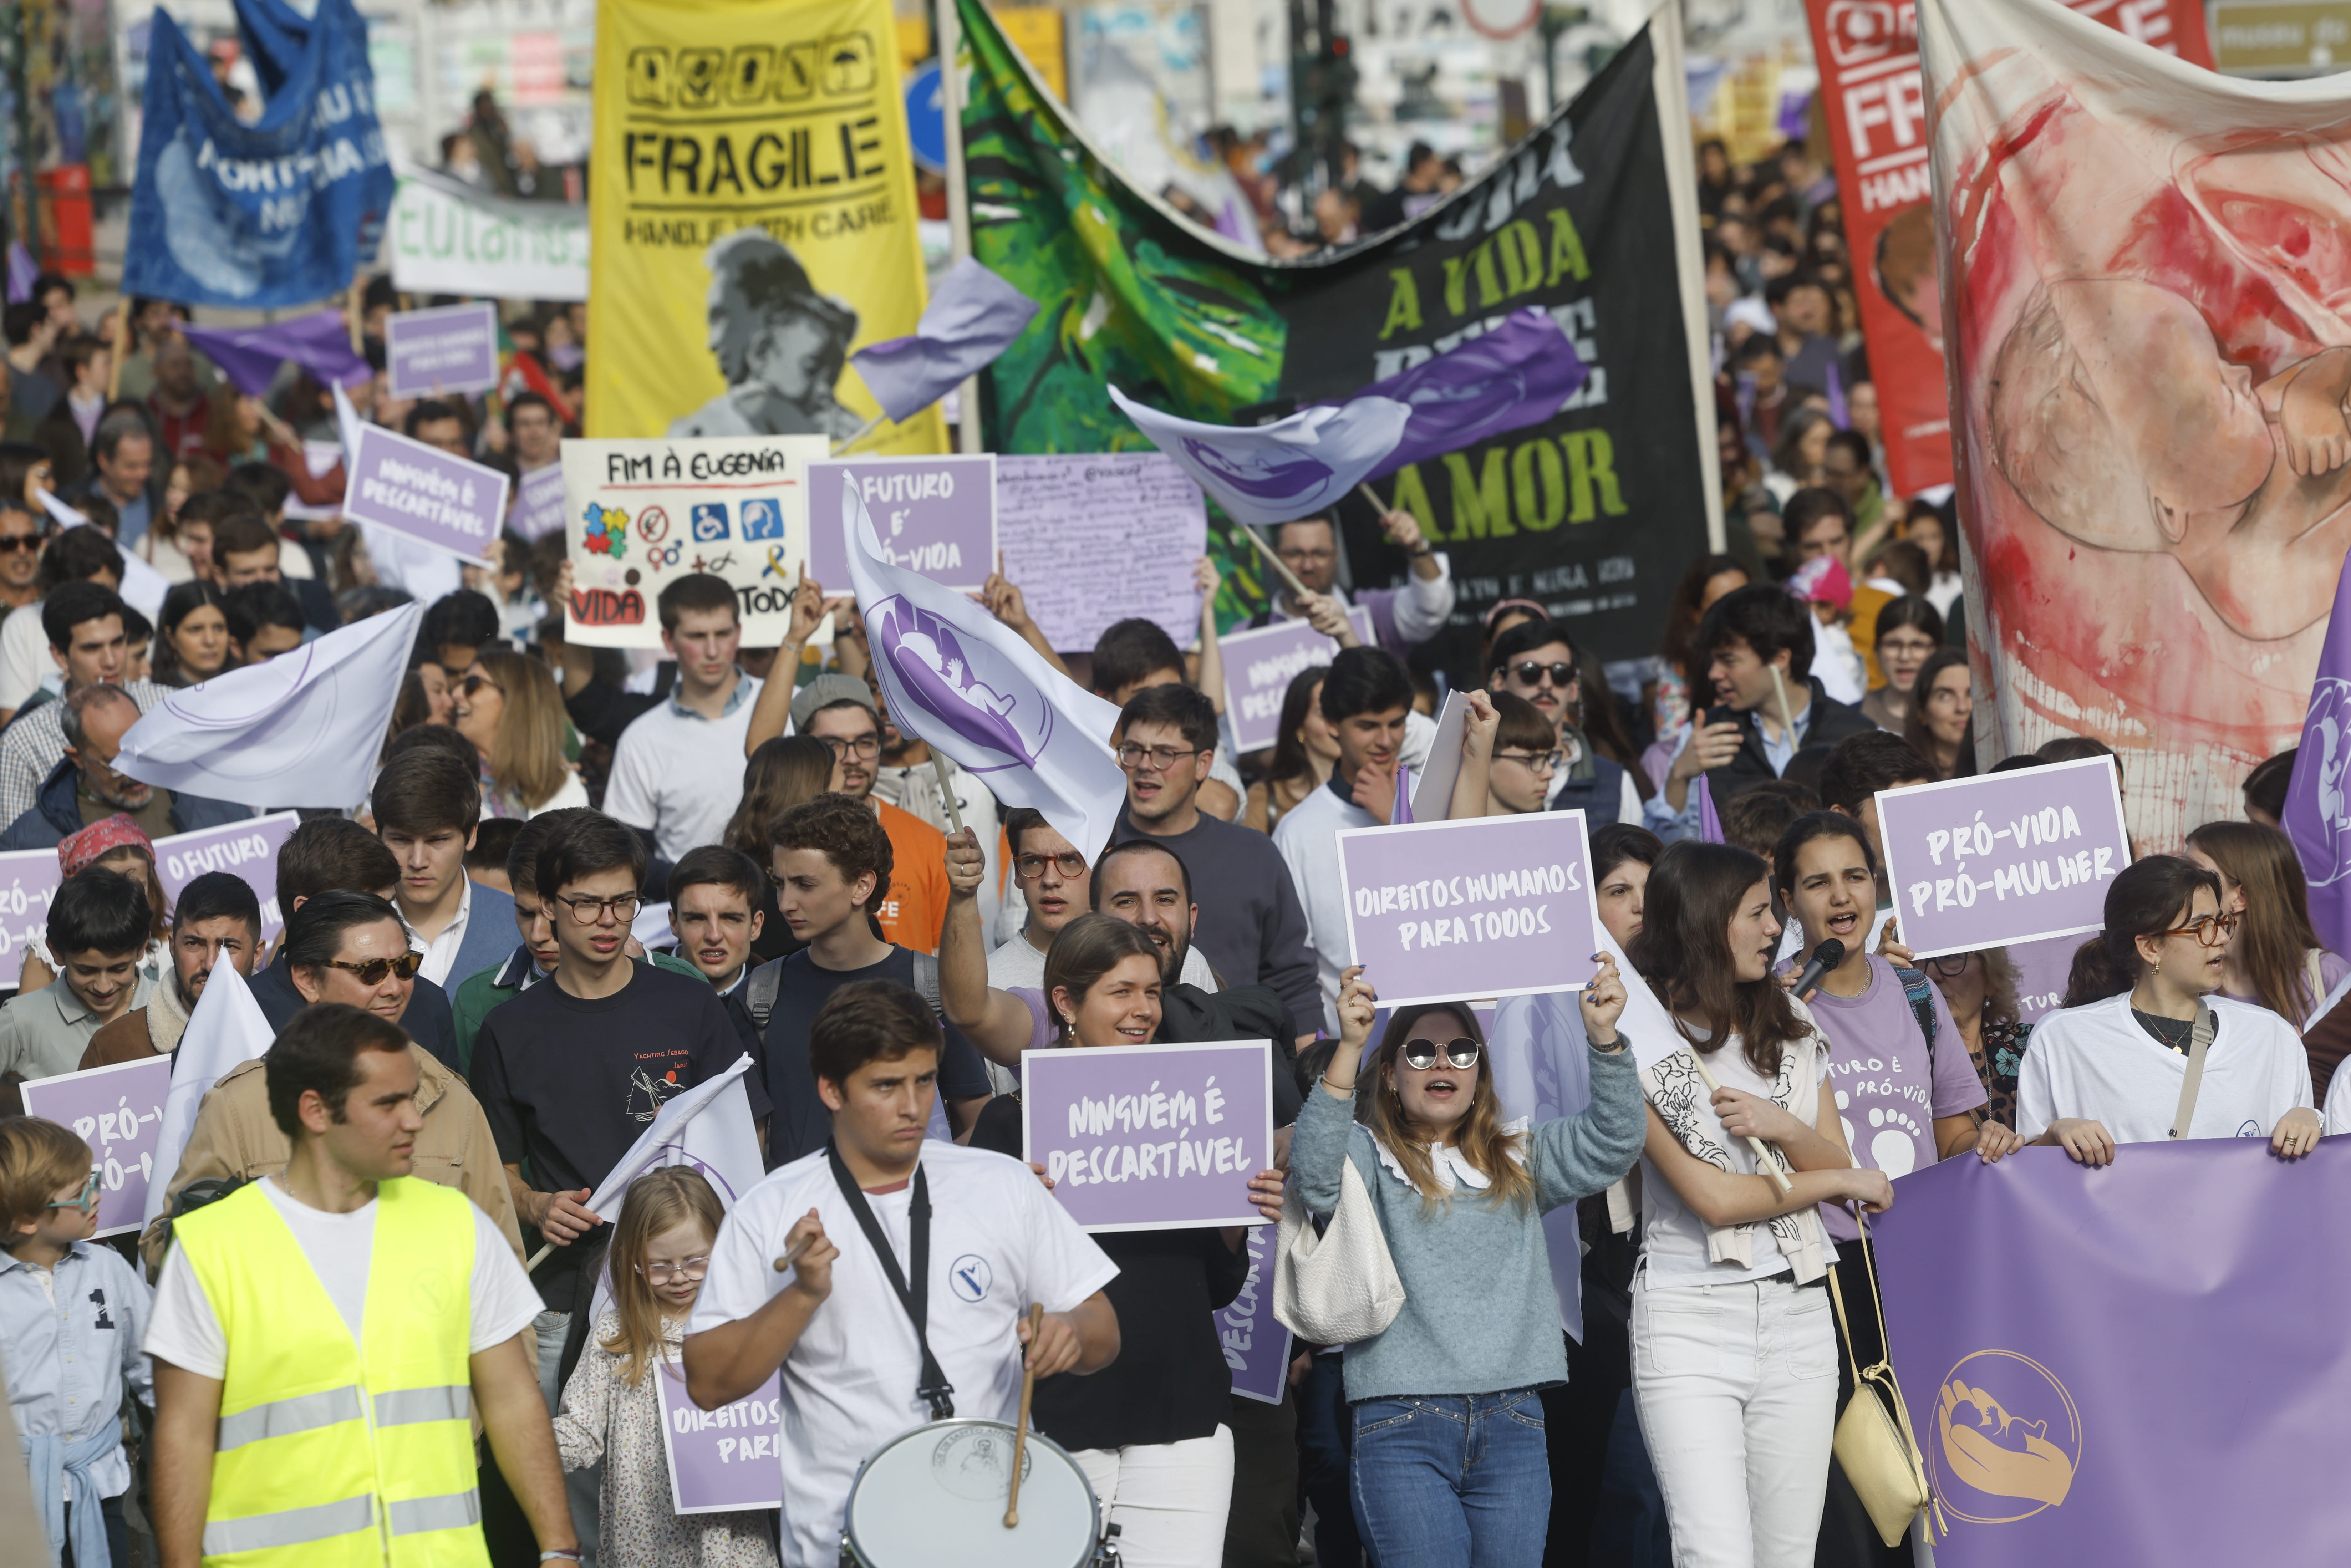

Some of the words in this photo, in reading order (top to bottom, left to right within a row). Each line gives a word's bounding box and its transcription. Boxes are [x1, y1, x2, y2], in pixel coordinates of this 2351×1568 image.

[625, 116, 885, 194] FRAGILE
[811, 195, 897, 240] CARE
[1378, 266, 1423, 340] A
[1442, 207, 1592, 316] VIDA
[607, 453, 652, 483] FIM
[663, 447, 681, 479] À
[862, 471, 955, 504] FUTURO
[1384, 428, 1629, 544] AMOR
[891, 508, 911, 536] É
[882, 537, 962, 572] Ó-VIDA
[572, 591, 641, 621] VIDA
[167, 855, 185, 880] O
[187, 834, 269, 873] FUTURO
[1926, 805, 2082, 865] PRÓ-VIDA
[1355, 876, 1464, 917] DIREITOS
[1466, 862, 1581, 903] HUMANOS
[1908, 846, 2116, 917] PRÓ-MULHER
[1398, 916, 1469, 951] PARA
[1470, 905, 1551, 942] TODOS
[1827, 1058, 1883, 1078] TURO
[1069, 1080, 1197, 1138] NINGUÉM
[1204, 1075, 1225, 1125] É
[1048, 1127, 1251, 1187] DESCARTÁVEL
[88, 1289, 115, 1329] 1
[673, 1398, 780, 1434] DIREITOS
